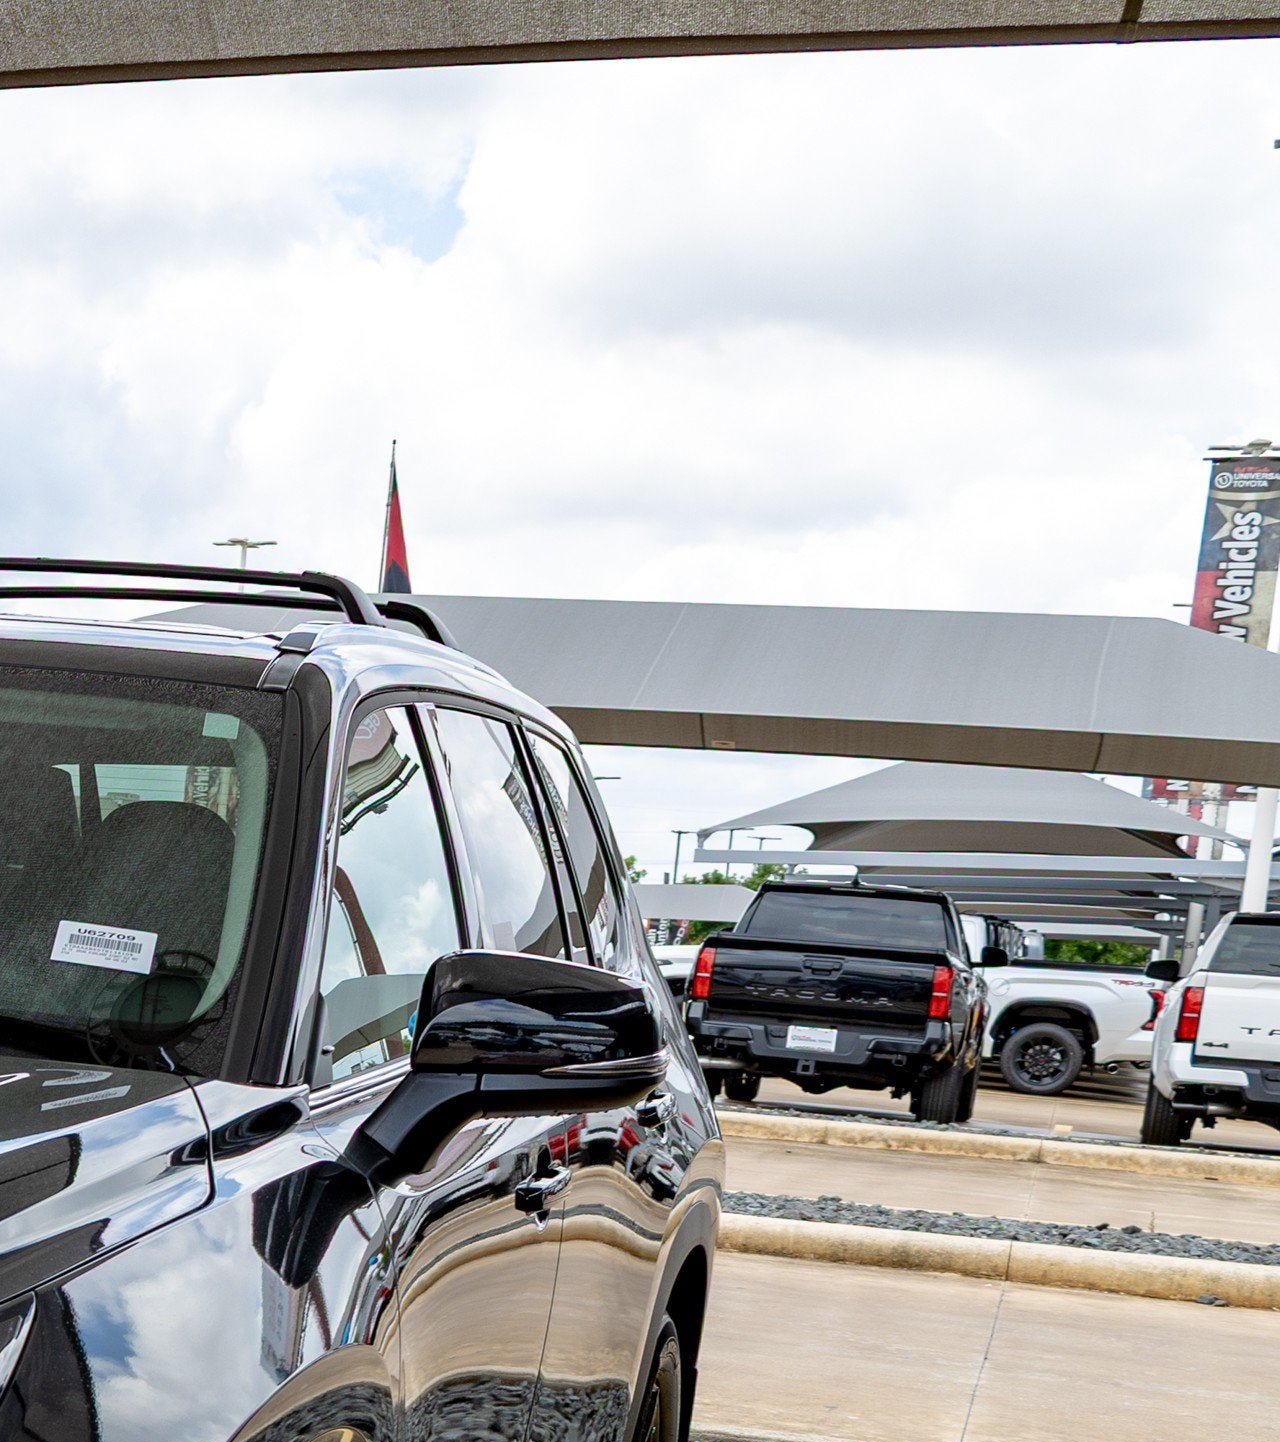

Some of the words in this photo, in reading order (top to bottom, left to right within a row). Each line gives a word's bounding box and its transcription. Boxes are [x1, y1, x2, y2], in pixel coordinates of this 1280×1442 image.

[1233, 472, 1280, 480] UNIVERSA
[1233, 480, 1269, 488] TOYOTA
[1212, 511, 1262, 619] Vehicles
[77, 928, 136, 941] U62709
[745, 985, 894, 1006] TACOMA
